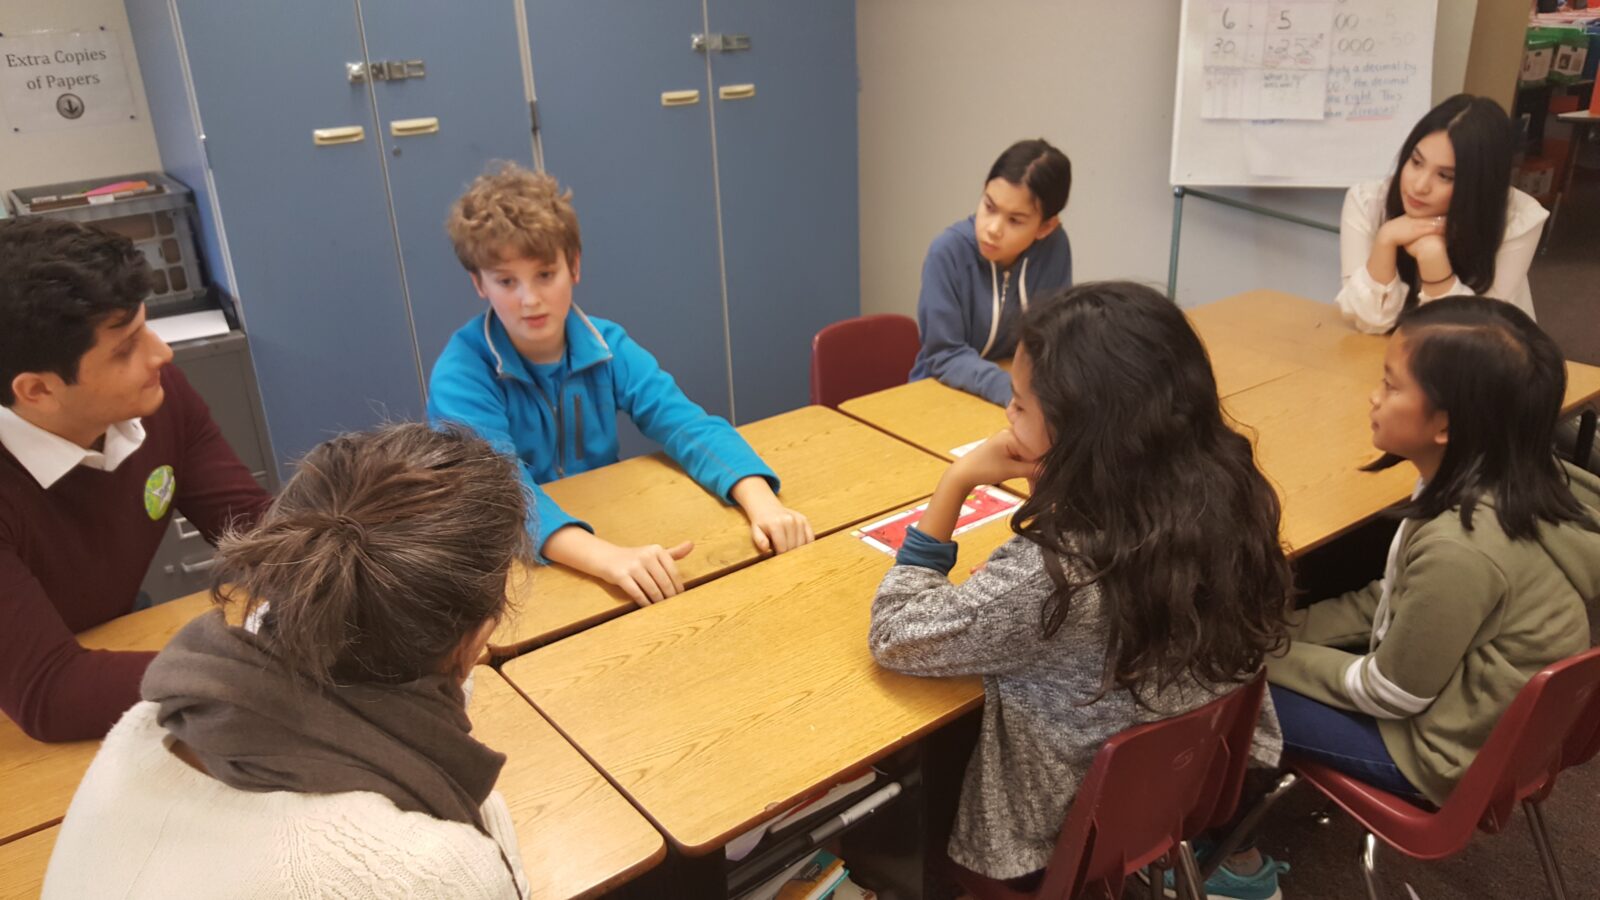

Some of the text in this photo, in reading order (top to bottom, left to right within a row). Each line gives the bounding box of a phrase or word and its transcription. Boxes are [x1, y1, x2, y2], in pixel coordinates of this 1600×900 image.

[1222, 7, 1292, 30] 6 5
[6, 49, 107, 68] Extra Copies
[26, 73, 101, 90] of Papers
